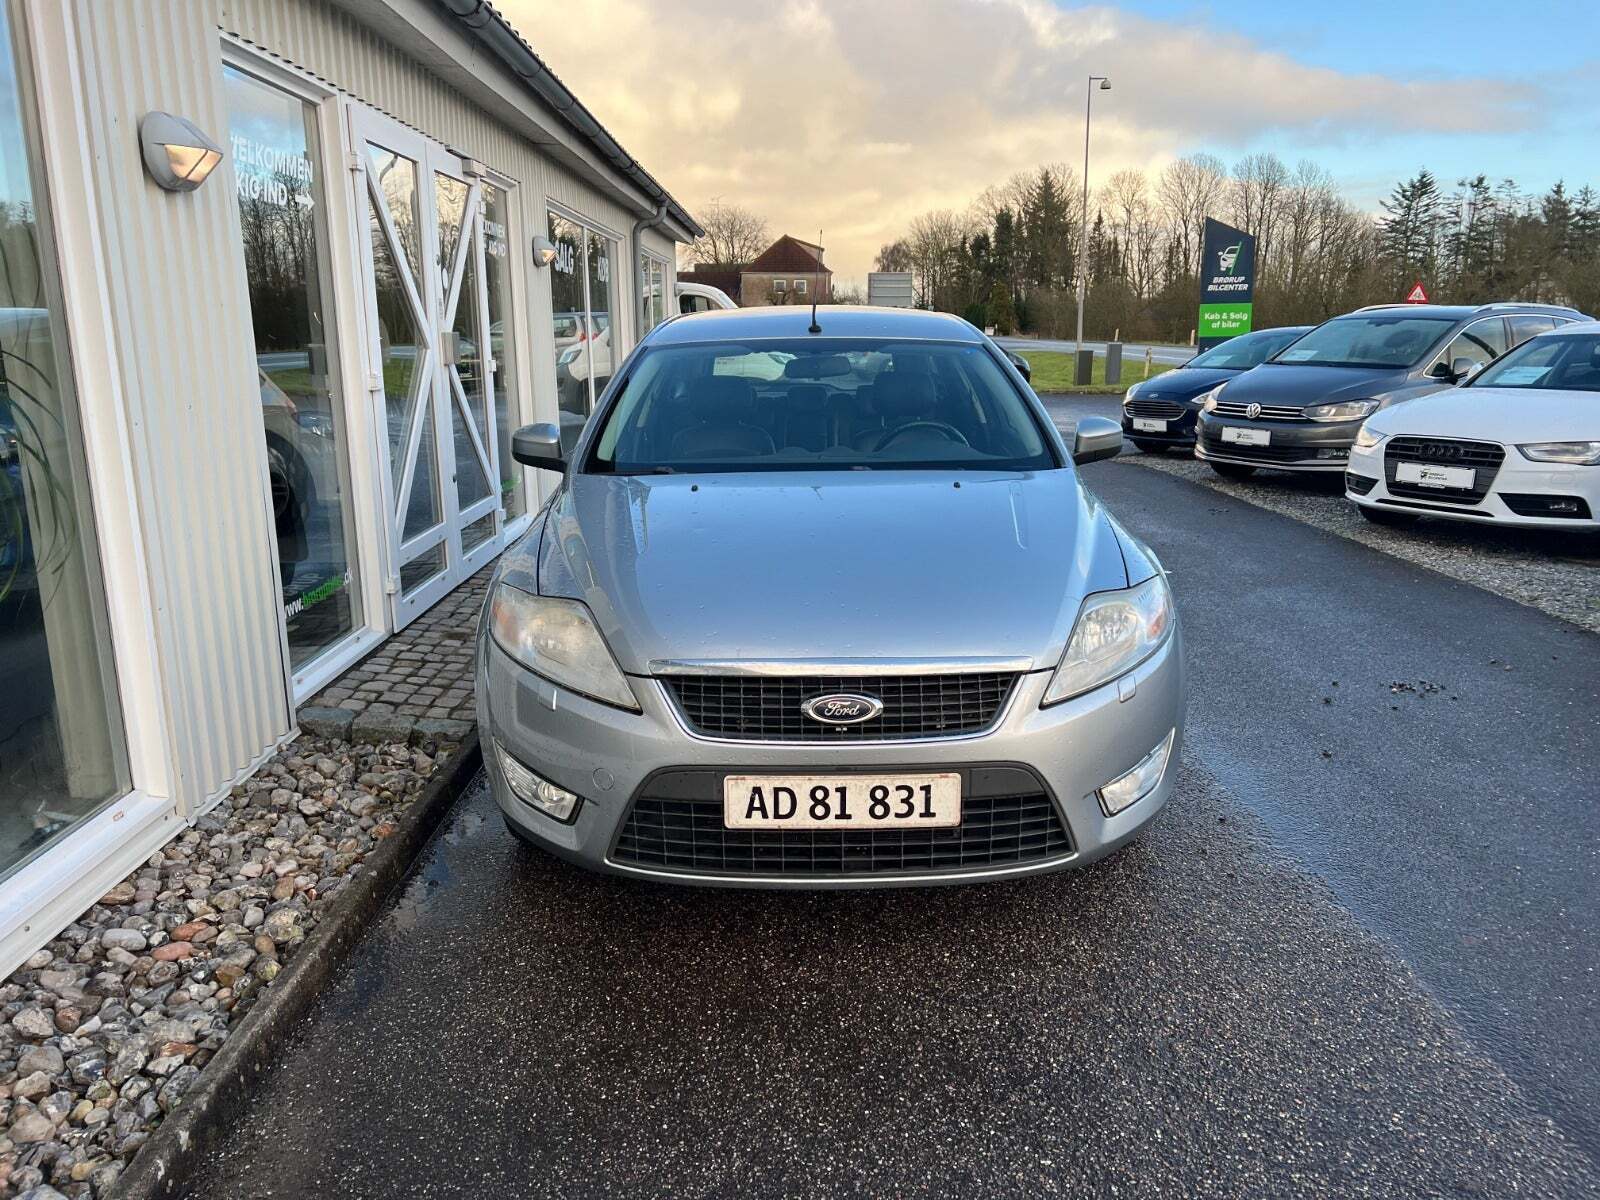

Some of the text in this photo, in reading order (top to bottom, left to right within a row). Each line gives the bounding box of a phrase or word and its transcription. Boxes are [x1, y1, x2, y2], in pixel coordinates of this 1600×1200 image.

[263, 175, 287, 206] IND
[554, 240, 574, 275] SALG
[1222, 320, 1240, 328] biler
[824, 701, 860, 716] Ford
[745, 784, 937, 821] AD 81 831
